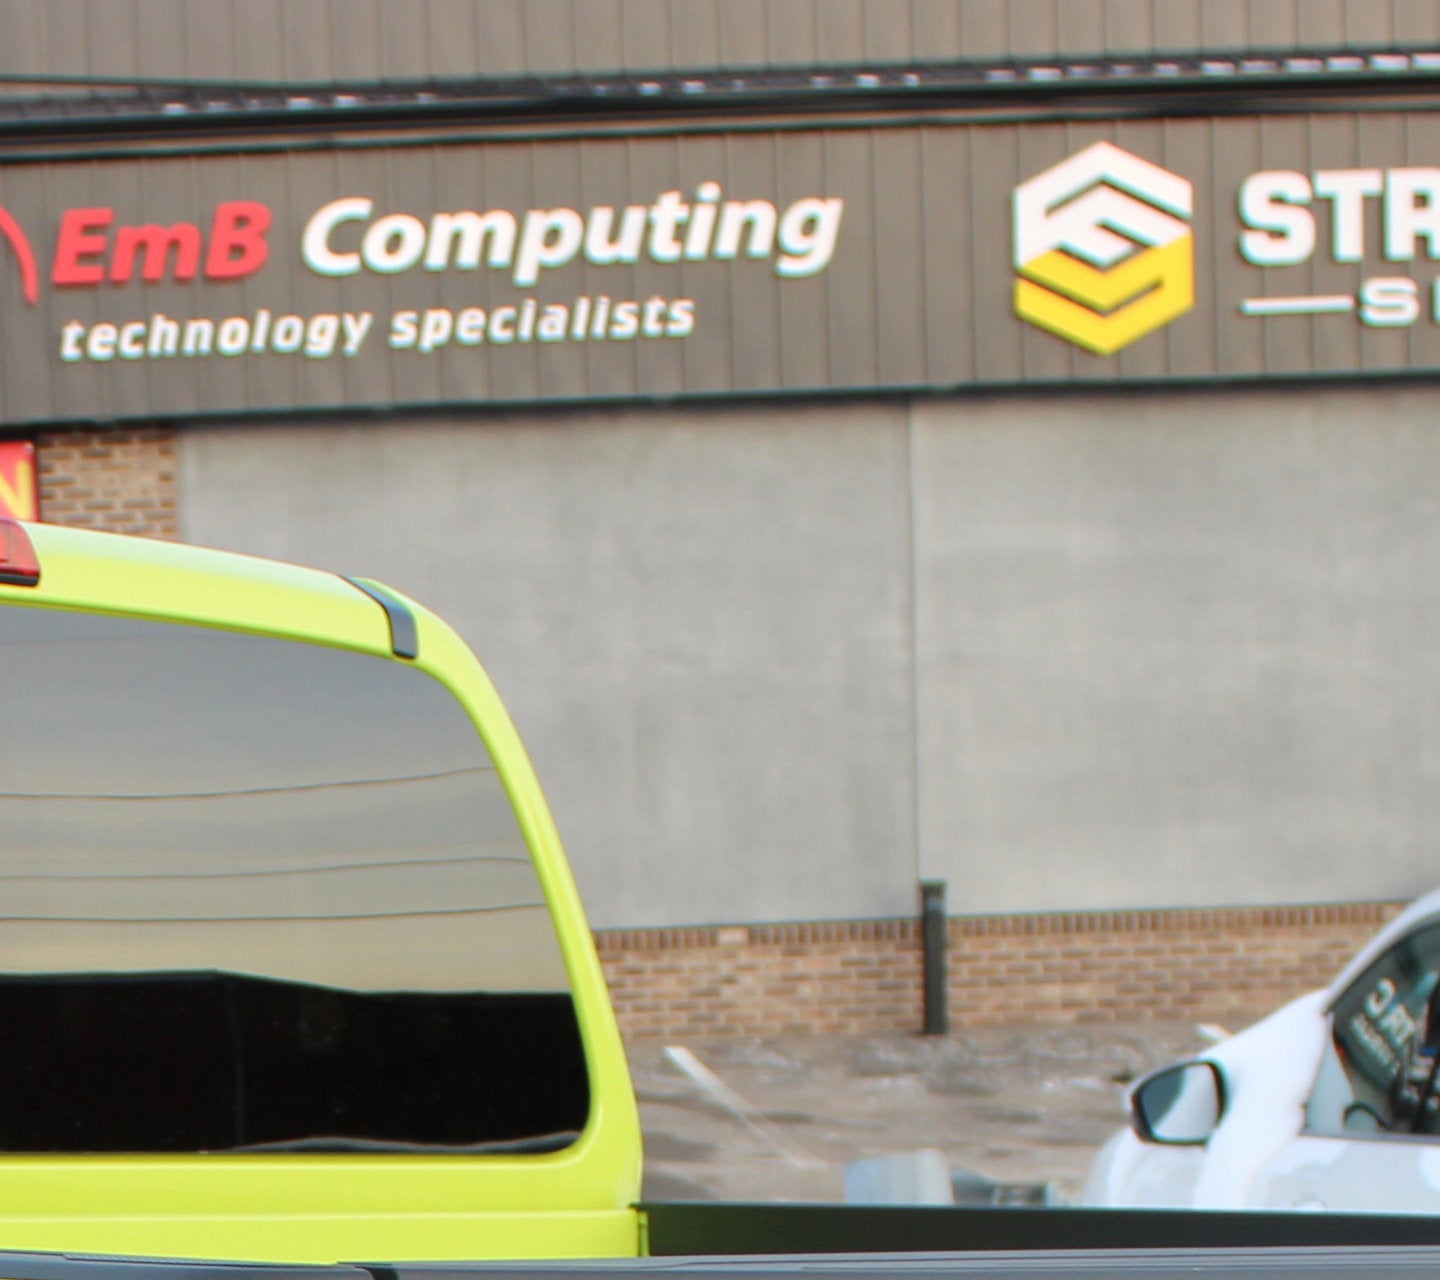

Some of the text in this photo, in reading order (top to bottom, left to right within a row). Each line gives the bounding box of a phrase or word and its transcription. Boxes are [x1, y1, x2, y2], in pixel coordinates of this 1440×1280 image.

[52, 183, 842, 286] EmB Computing
[60, 294, 694, 361] technology specialists
